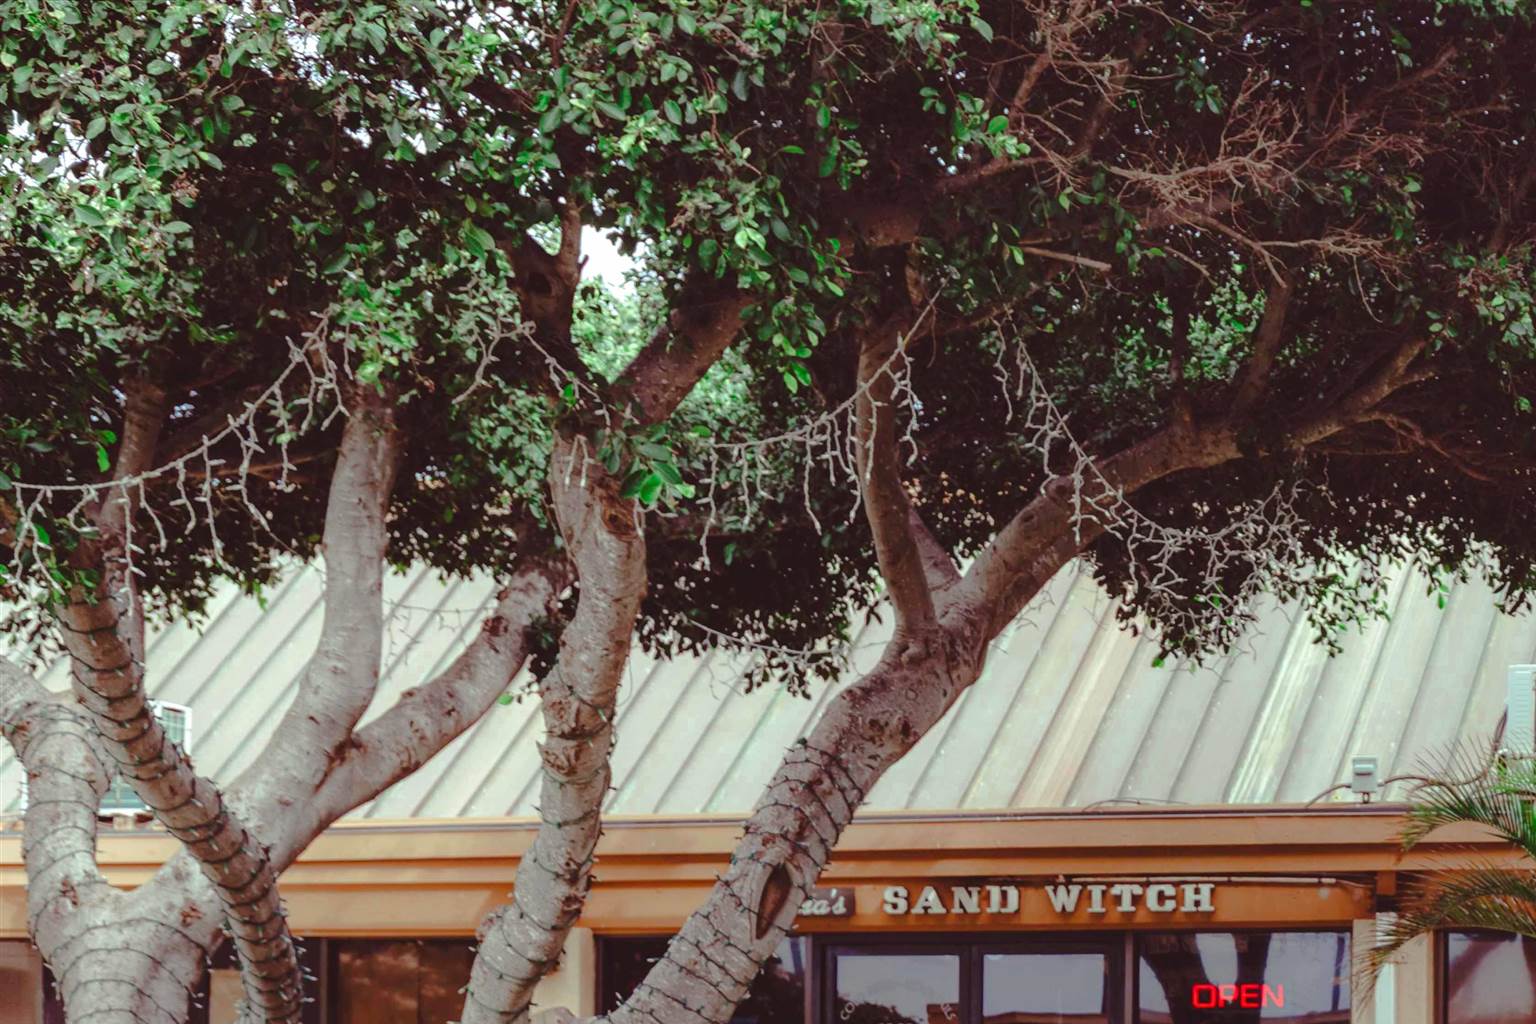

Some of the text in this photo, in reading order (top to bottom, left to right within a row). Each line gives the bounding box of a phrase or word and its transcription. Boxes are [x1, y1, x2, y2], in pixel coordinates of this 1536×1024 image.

[882, 886, 1019, 914] SAND
[1045, 884, 1215, 914] WITCH
[1192, 983, 1285, 1008] OPEN
